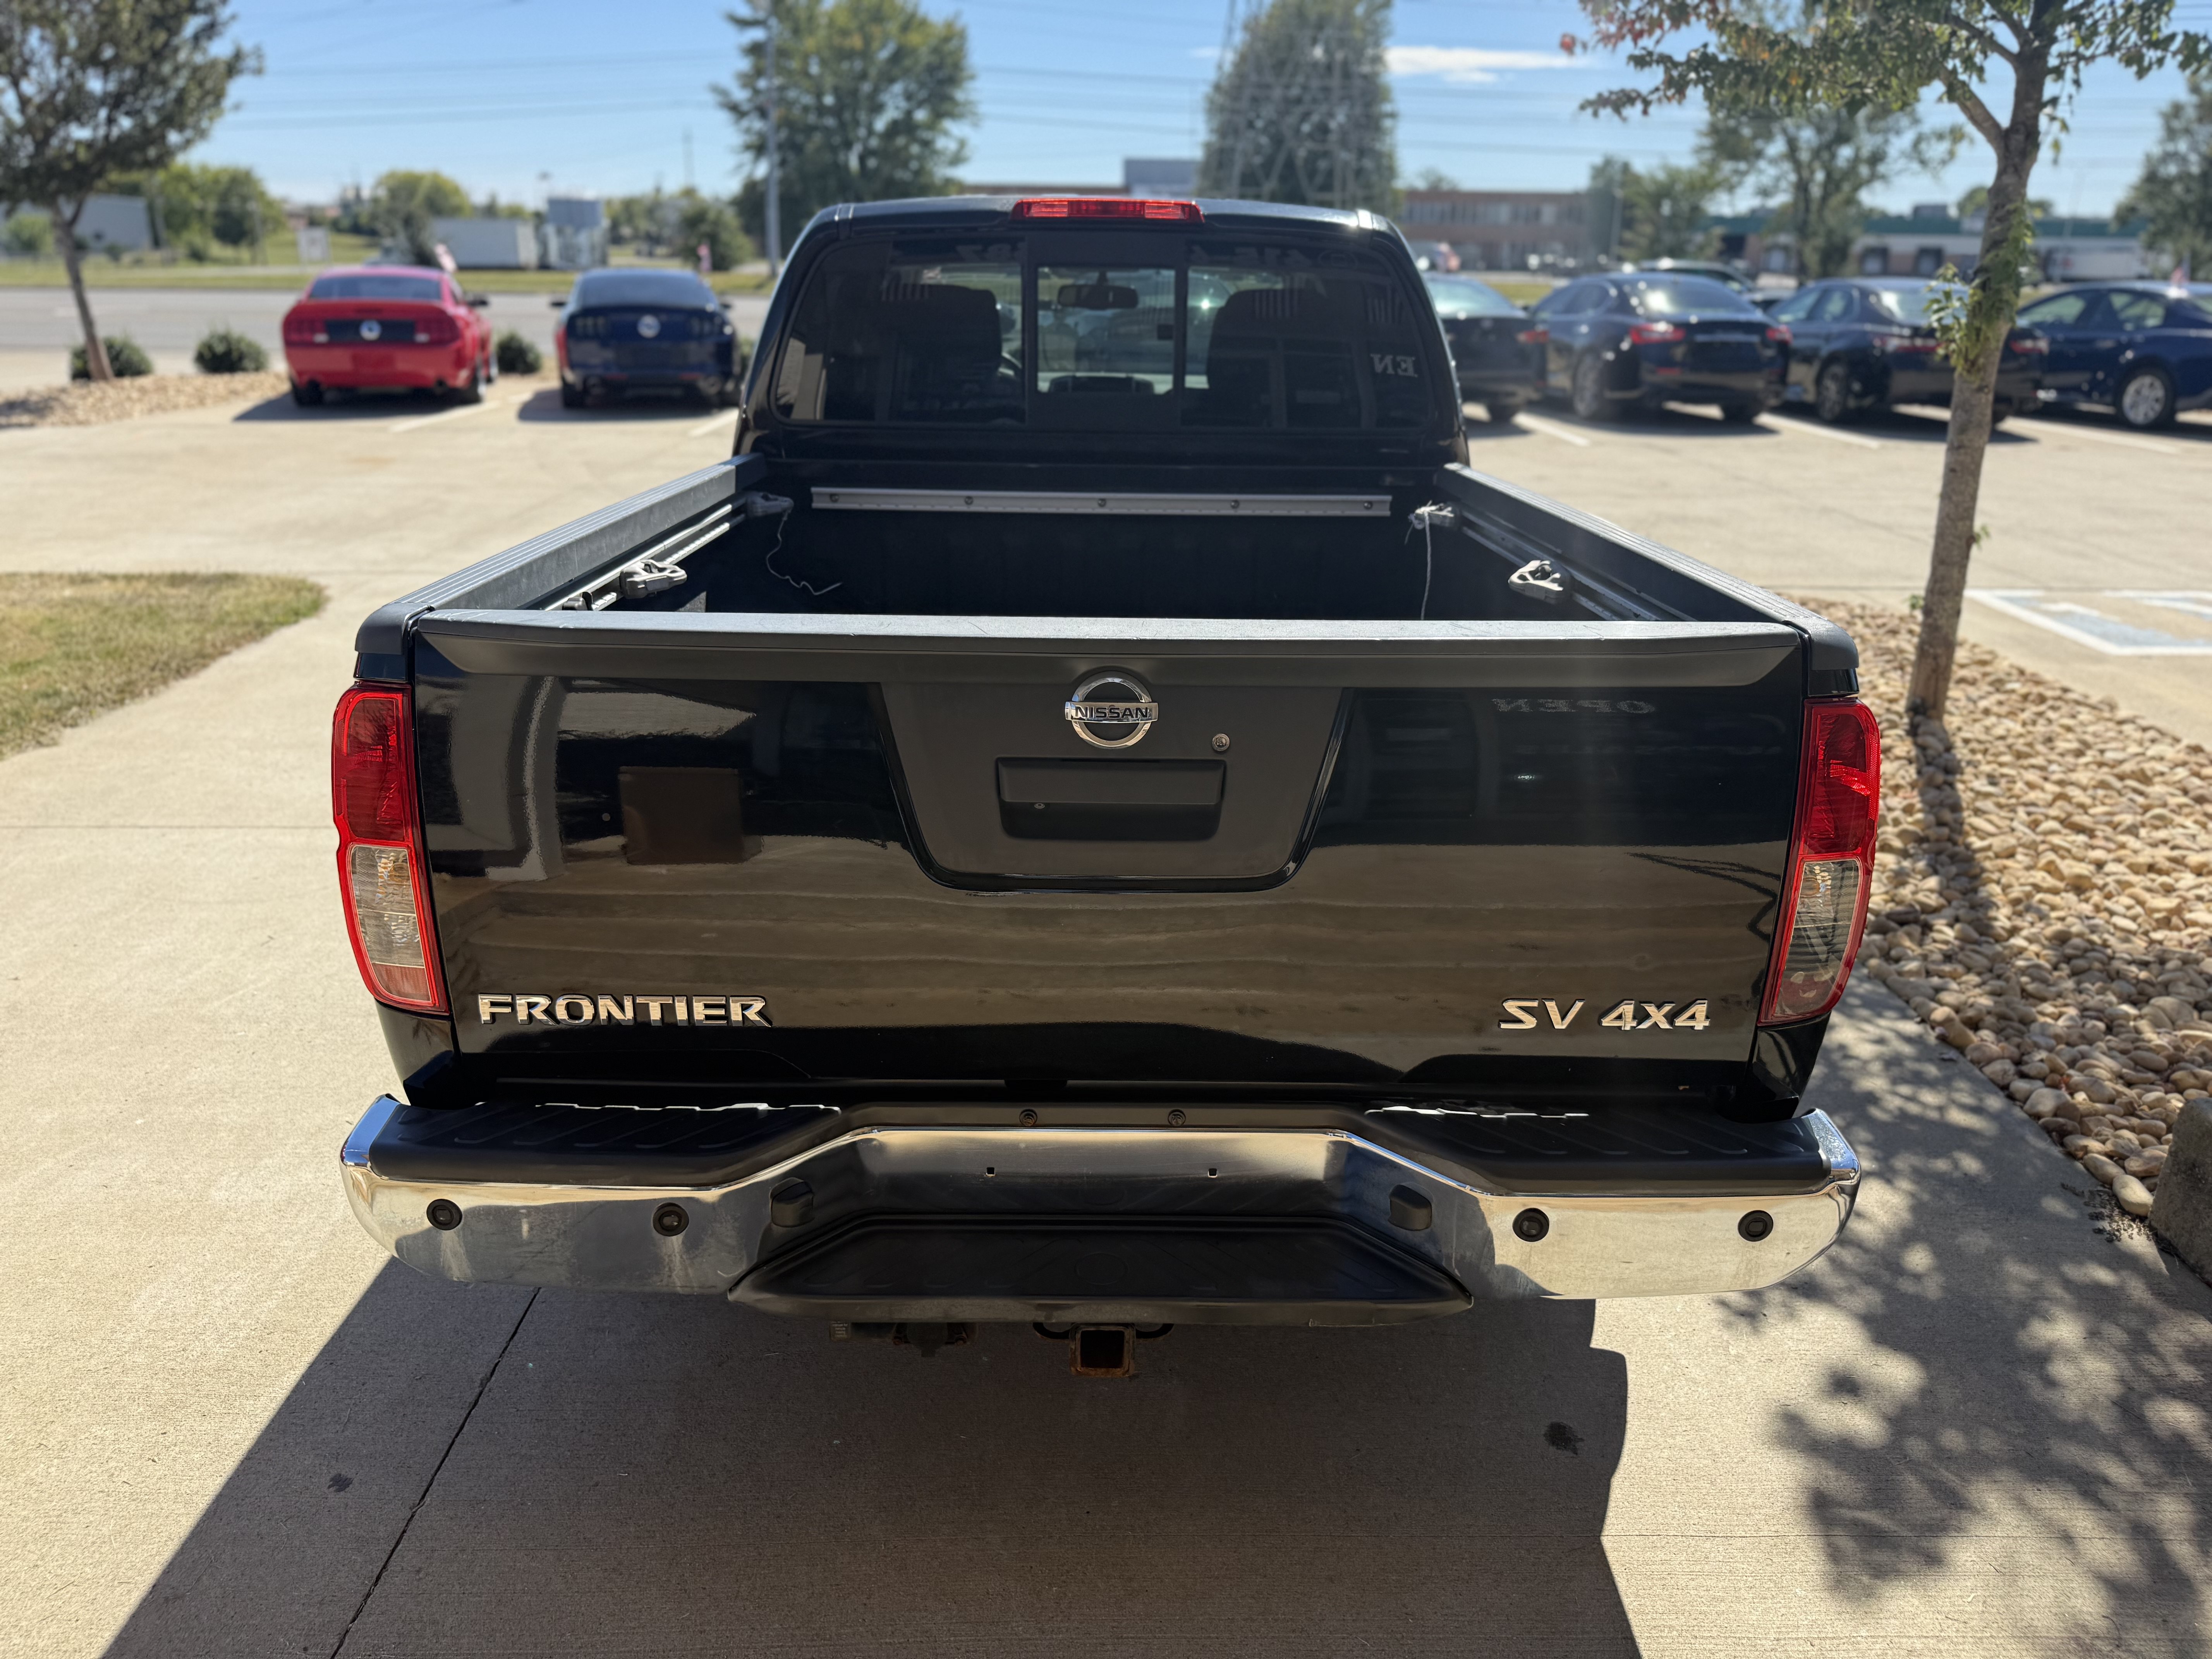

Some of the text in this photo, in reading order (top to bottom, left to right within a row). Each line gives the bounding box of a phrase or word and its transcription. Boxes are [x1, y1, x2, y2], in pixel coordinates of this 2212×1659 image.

[1075, 706, 1149, 718] NISSAN
[478, 993, 772, 1027] FRONTIER
[1499, 998, 1585, 1029] SV
